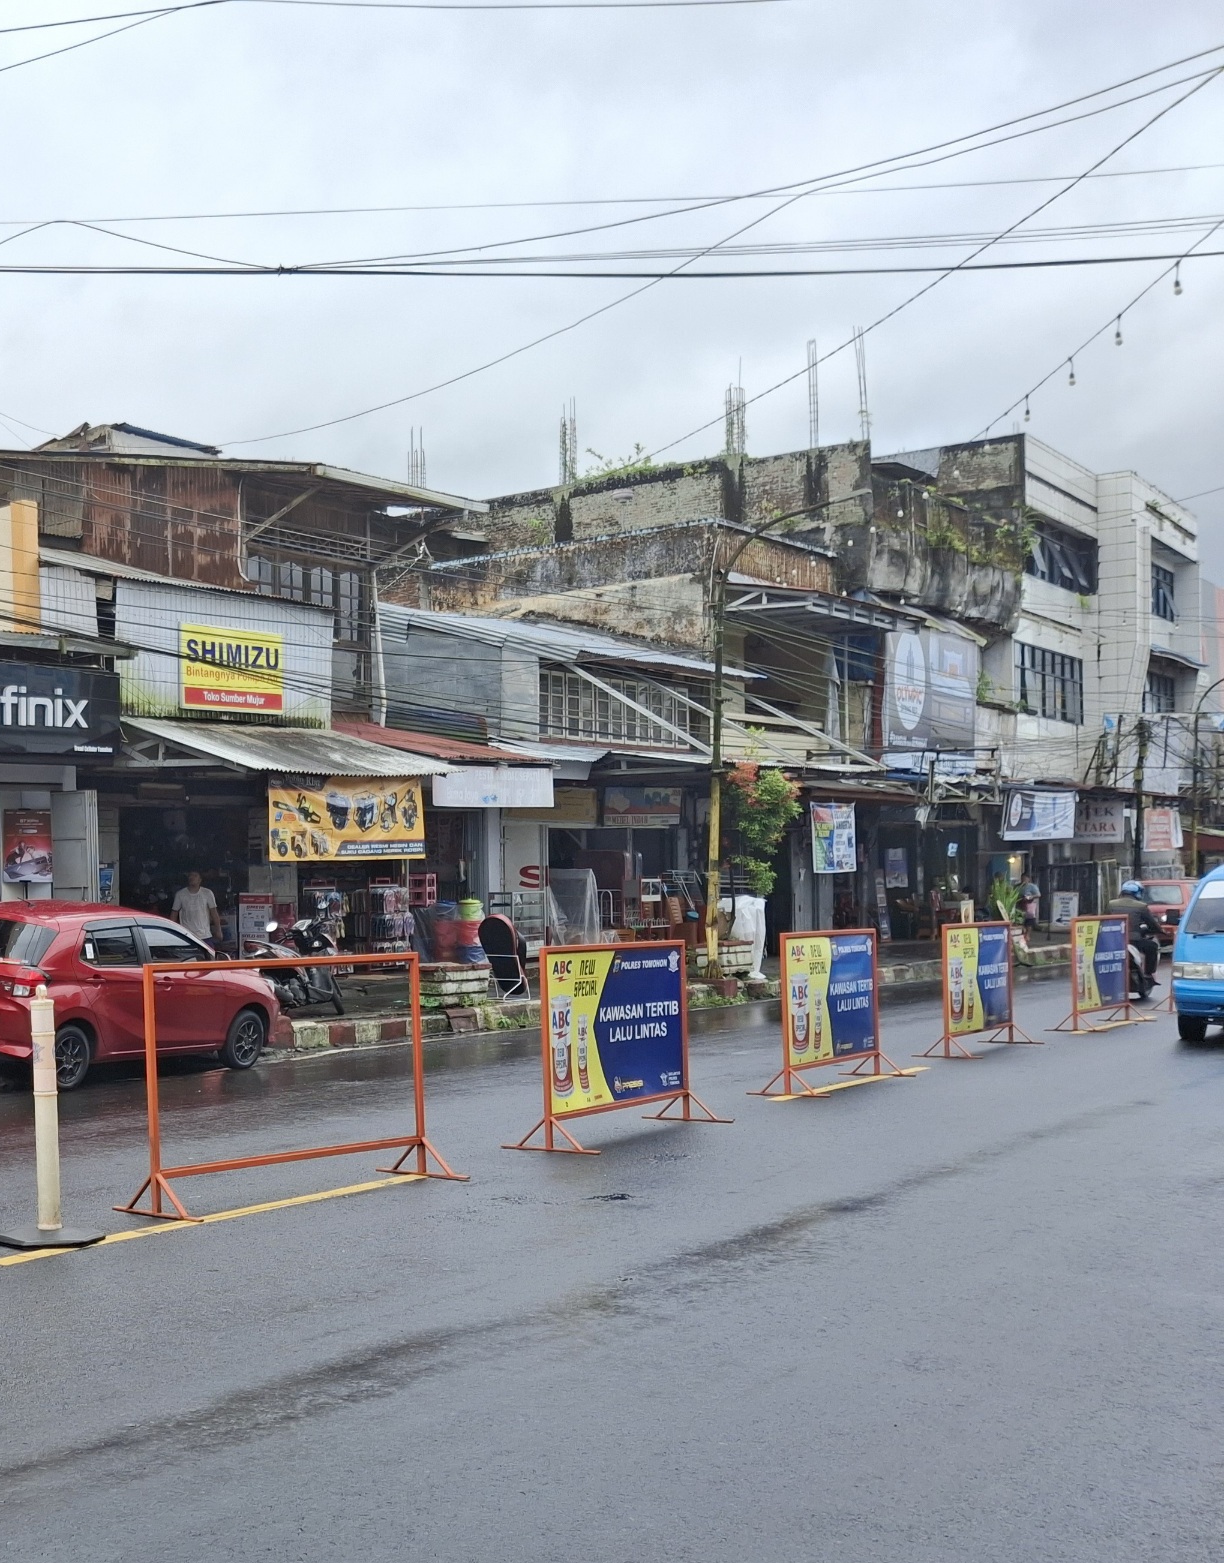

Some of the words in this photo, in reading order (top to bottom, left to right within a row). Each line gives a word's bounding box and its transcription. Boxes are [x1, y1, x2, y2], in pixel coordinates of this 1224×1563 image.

[186, 638, 279, 670] SHIMIZU
[186, 666, 235, 682] Bintangnya
[203, 691, 220, 701] Toko
[220, 693, 245, 703] Sumber
[246, 695, 265, 706] Mujur
[950, 934, 960, 943] ABC
[791, 945, 806, 957] ABC
[552, 960, 573, 975] ABC
[579, 960, 596, 976] NEW
[620, 960, 641, 970] POLRES
[642, 959, 668, 968] TOMOHON
[950, 966, 963, 979] ABC
[573, 980, 598, 998] SPECIAL
[792, 985, 808, 1001] ABC
[829, 981, 857, 996] KAWASAN
[857, 979, 873, 993] TERTIB
[599, 1003, 644, 1022] KAWASAN
[645, 1001, 679, 1017] TERTIB
[837, 998, 852, 1012] LALU
[852, 996, 869, 1010] LINTAS
[552, 1009, 571, 1029] ABC
[609, 1025, 633, 1043] LALU
[634, 1022, 668, 1040] LINTAS
